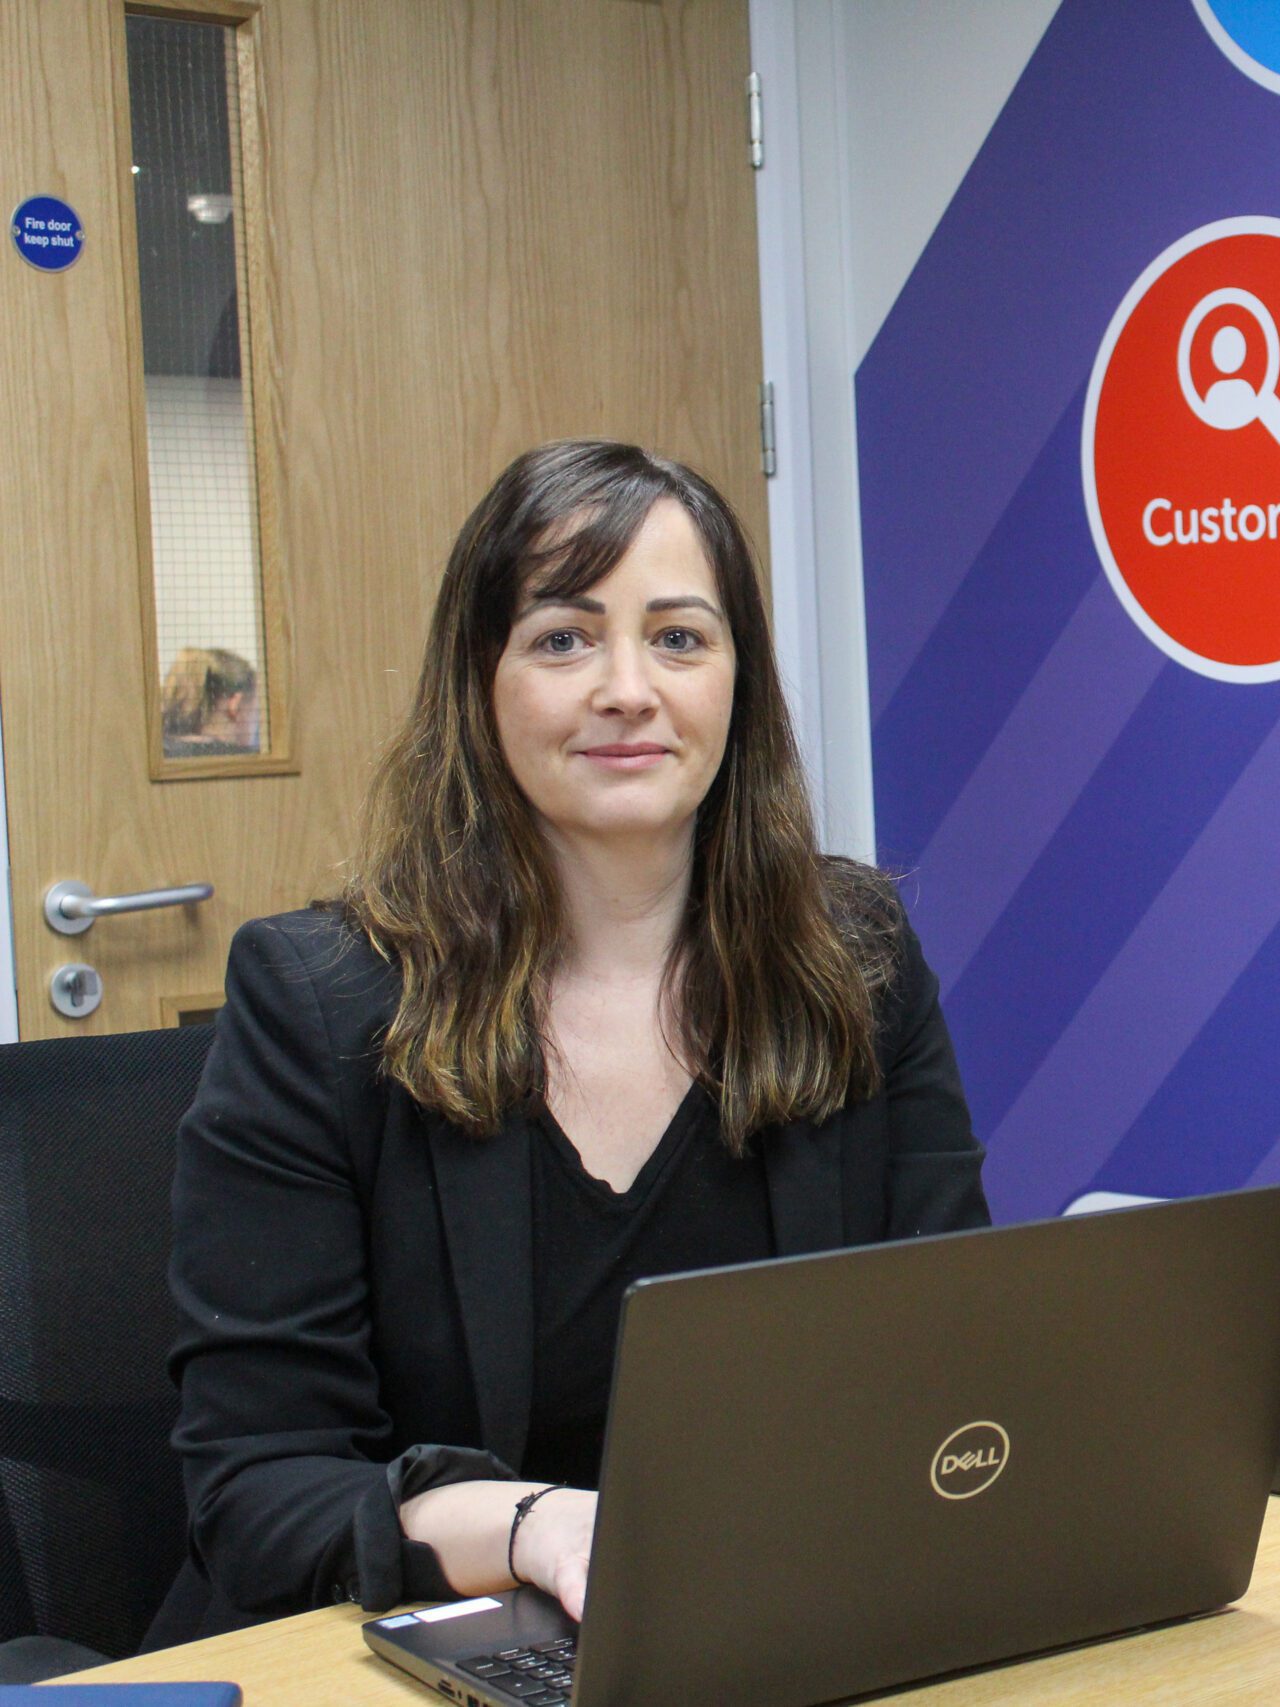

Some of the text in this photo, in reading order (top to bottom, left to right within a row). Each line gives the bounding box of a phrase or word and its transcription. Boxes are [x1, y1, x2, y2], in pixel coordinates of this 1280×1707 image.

[25, 217, 72, 231] Fire door
[24, 232, 74, 248] keep shut
[941, 1446, 1000, 1475] DELL
